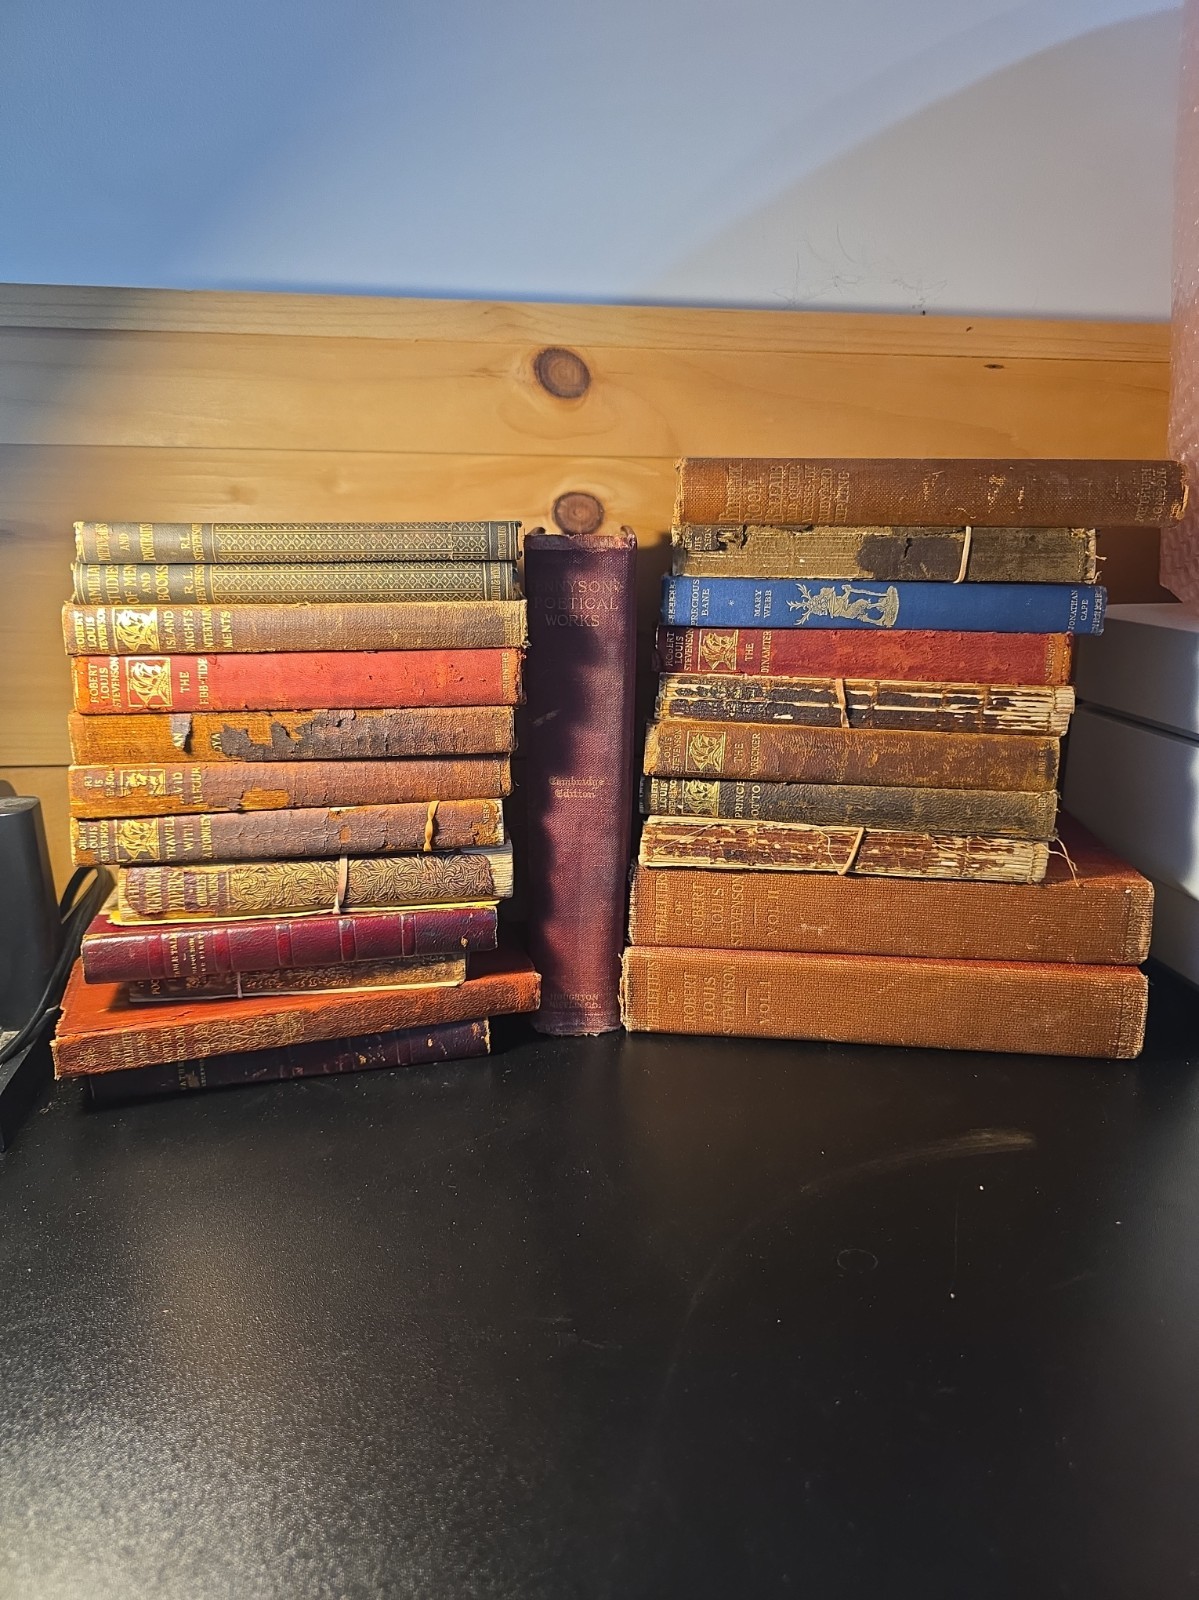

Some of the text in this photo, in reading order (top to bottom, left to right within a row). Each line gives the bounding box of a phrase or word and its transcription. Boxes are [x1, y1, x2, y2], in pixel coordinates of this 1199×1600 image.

[119, 534, 130, 551] AND
[140, 524, 156, 560] PORTRAITS
[192, 524, 205, 560] STEVENSON
[124, 565, 139, 604] OF MEN
[141, 573, 151, 593] AND
[156, 565, 171, 601] BOOKS
[183, 568, 193, 593] R.L.
[195, 565, 207, 604] STEVENSO
[534, 598, 618, 609] POETICAL
[691, 579, 699, 625] PRECIOUS
[764, 590, 772, 618] WEBB
[1068, 590, 1078, 630] JONATHAN
[1080, 599, 1088, 620] CAPE
[85, 617, 96, 646] LOUIS
[164, 611, 176, 649] ISLAND
[222, 611, 233, 647] MENTS
[546, 615, 600, 626] WORKS
[666, 632, 674, 666] ROBERT
[685, 629, 694, 671] STEVENSON
[745, 643, 754, 661] THE
[762, 631, 772, 672] DYNAMITER
[99, 668, 109, 698] LOUIS
[110, 657, 120, 707] STEVENSON
[180, 672, 189, 692] THE
[663, 736, 672, 763] LOUIS
[673, 729, 682, 771] STEVENSON
[734, 743, 743, 762] THE
[751, 733, 761, 775] WRECKER
[548, 776, 605, 789] Cambridge
[555, 789, 595, 797] Edition
[660, 782, 668, 808] LOUIS
[735, 781, 745, 818] PRINCE
[752, 785, 761, 816] OTTO
[184, 824, 194, 850] WITH
[201, 814, 212, 850] DONKEY
[128, 882, 139, 904] THE
[169, 871, 184, 910] PAPERS
[656, 874, 667, 920] LETTERS
[675, 901, 683, 915] OF
[692, 882, 704, 935] ROBERT
[712, 888, 724, 930] LOUIS
[731, 875, 744, 946] STEVENSON
[647, 962, 659, 1005] LETTERS
[667, 989, 675, 1003] OF
[684, 971, 696, 1023] ROBERT
[703, 977, 715, 1020] LOUIS
[723, 965, 735, 1034] STEVENSON
